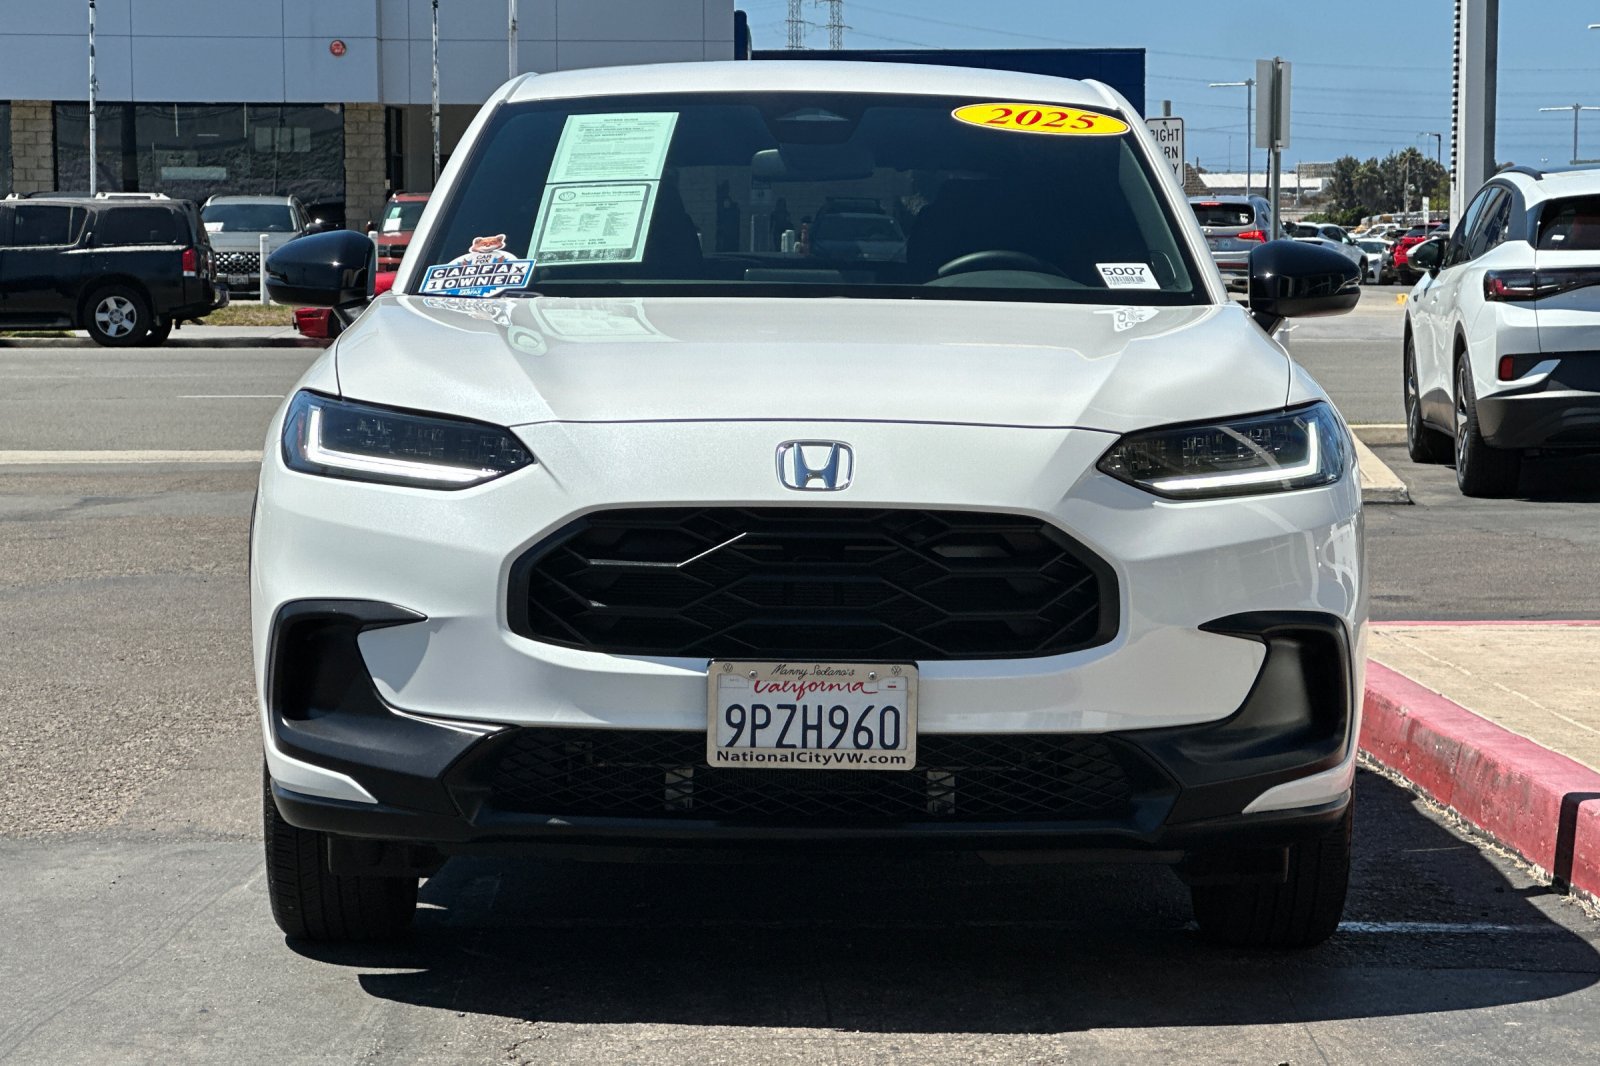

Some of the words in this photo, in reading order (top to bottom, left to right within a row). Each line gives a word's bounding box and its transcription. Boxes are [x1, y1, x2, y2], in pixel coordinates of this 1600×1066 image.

[985, 108, 1099, 129] 2025
[433, 264, 527, 278] CARFAX
[1102, 267, 1145, 276] 5007
[429, 280, 438, 289] 1
[444, 275, 521, 288] OWNER
[771, 663, 808, 680] Manny
[753, 679, 879, 701] California
[725, 703, 901, 750] 9PZH960
[716, 750, 907, 765] NationalCityVW.com
